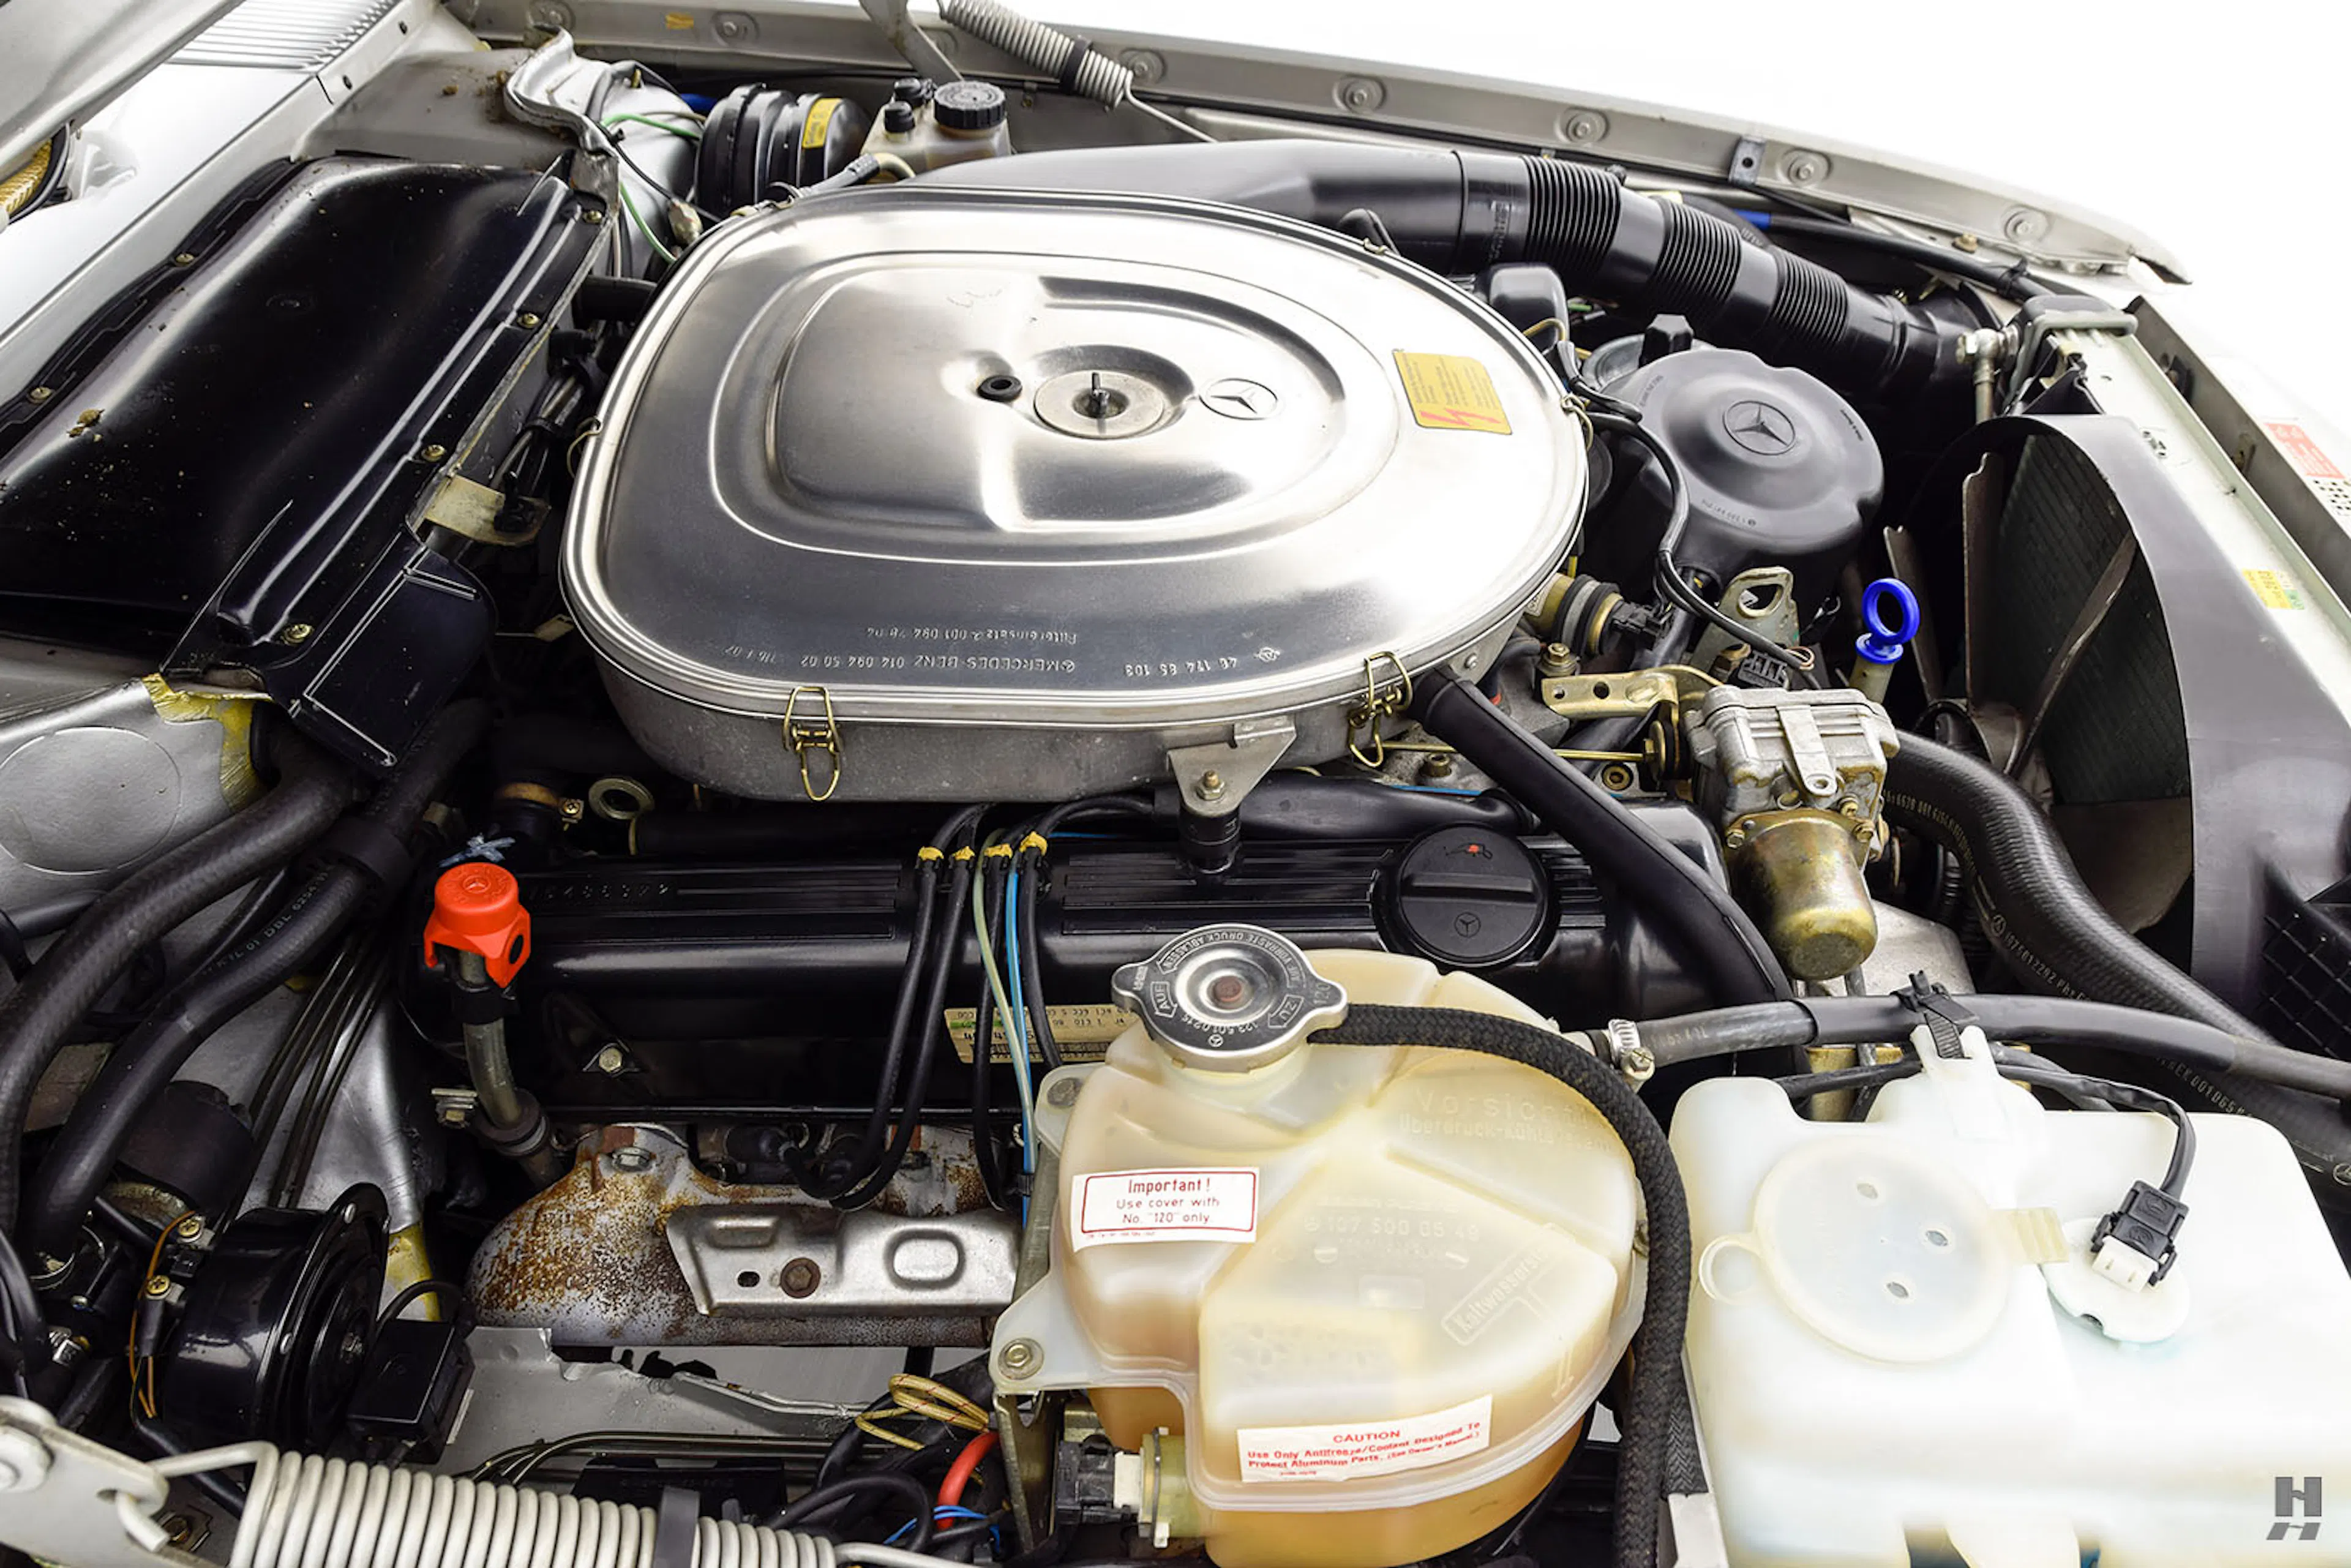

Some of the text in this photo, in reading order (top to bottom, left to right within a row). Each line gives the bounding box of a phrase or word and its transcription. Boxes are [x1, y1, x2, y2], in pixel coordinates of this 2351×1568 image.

[1155, 984, 1171, 1010] AUF
[1313, 983, 1330, 1004] 120
[1278, 999, 1297, 1020] ZU
[1117, 1196, 1220, 1209] Use cover with
[1333, 1430, 1401, 1443] CAUTION
[1274, 1450, 1299, 1459] Only
